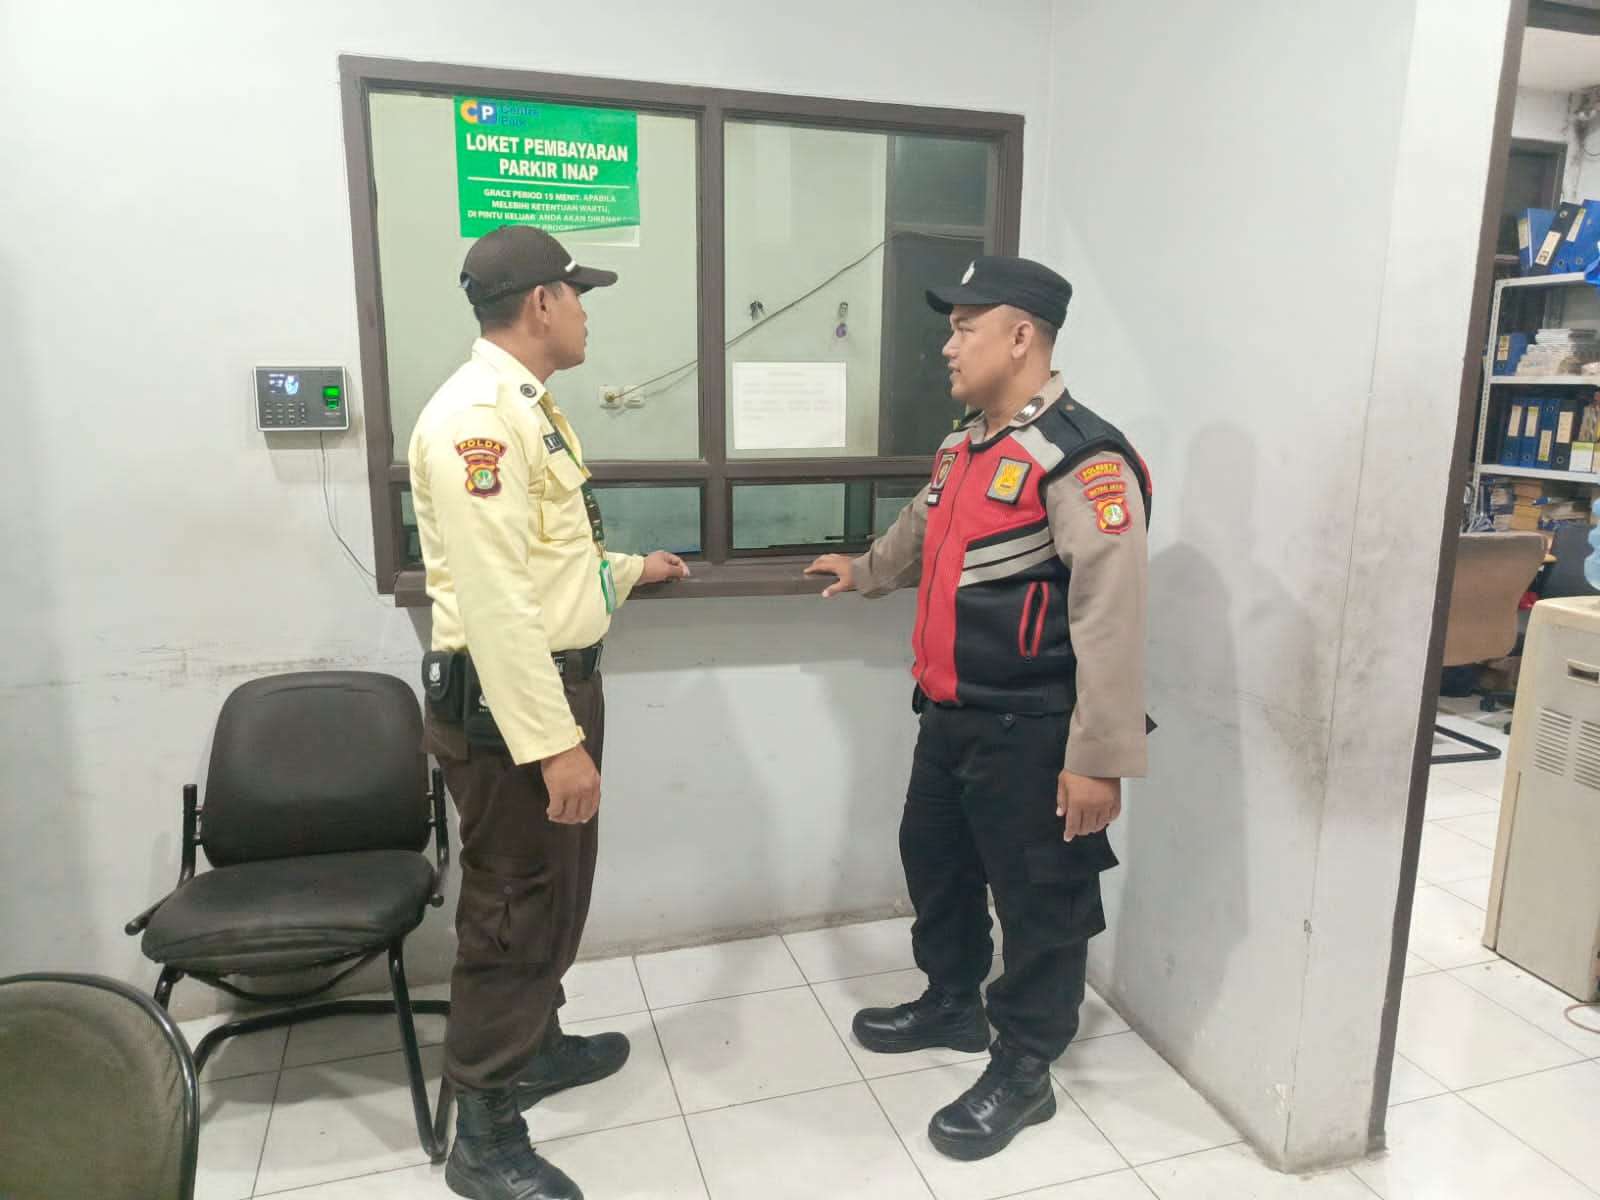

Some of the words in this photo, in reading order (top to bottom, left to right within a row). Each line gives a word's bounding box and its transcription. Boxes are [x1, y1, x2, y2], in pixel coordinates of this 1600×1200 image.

[466, 133, 519, 153] LOKET
[524, 138, 629, 162] PEMBAYARAN
[499, 158, 557, 179] PARKIR
[562, 163, 599, 181] INAP
[484, 188, 512, 198] GRACE
[513, 190, 543, 200] PERIOD
[491, 200, 529, 210] MELEBIHI
[531, 202, 579, 212] KETENTUAN
[467, 210, 478, 218] DI
[478, 210, 503, 219] PINTU
[538, 213, 562, 222] ANDA
[459, 439, 502, 453] POLDA
